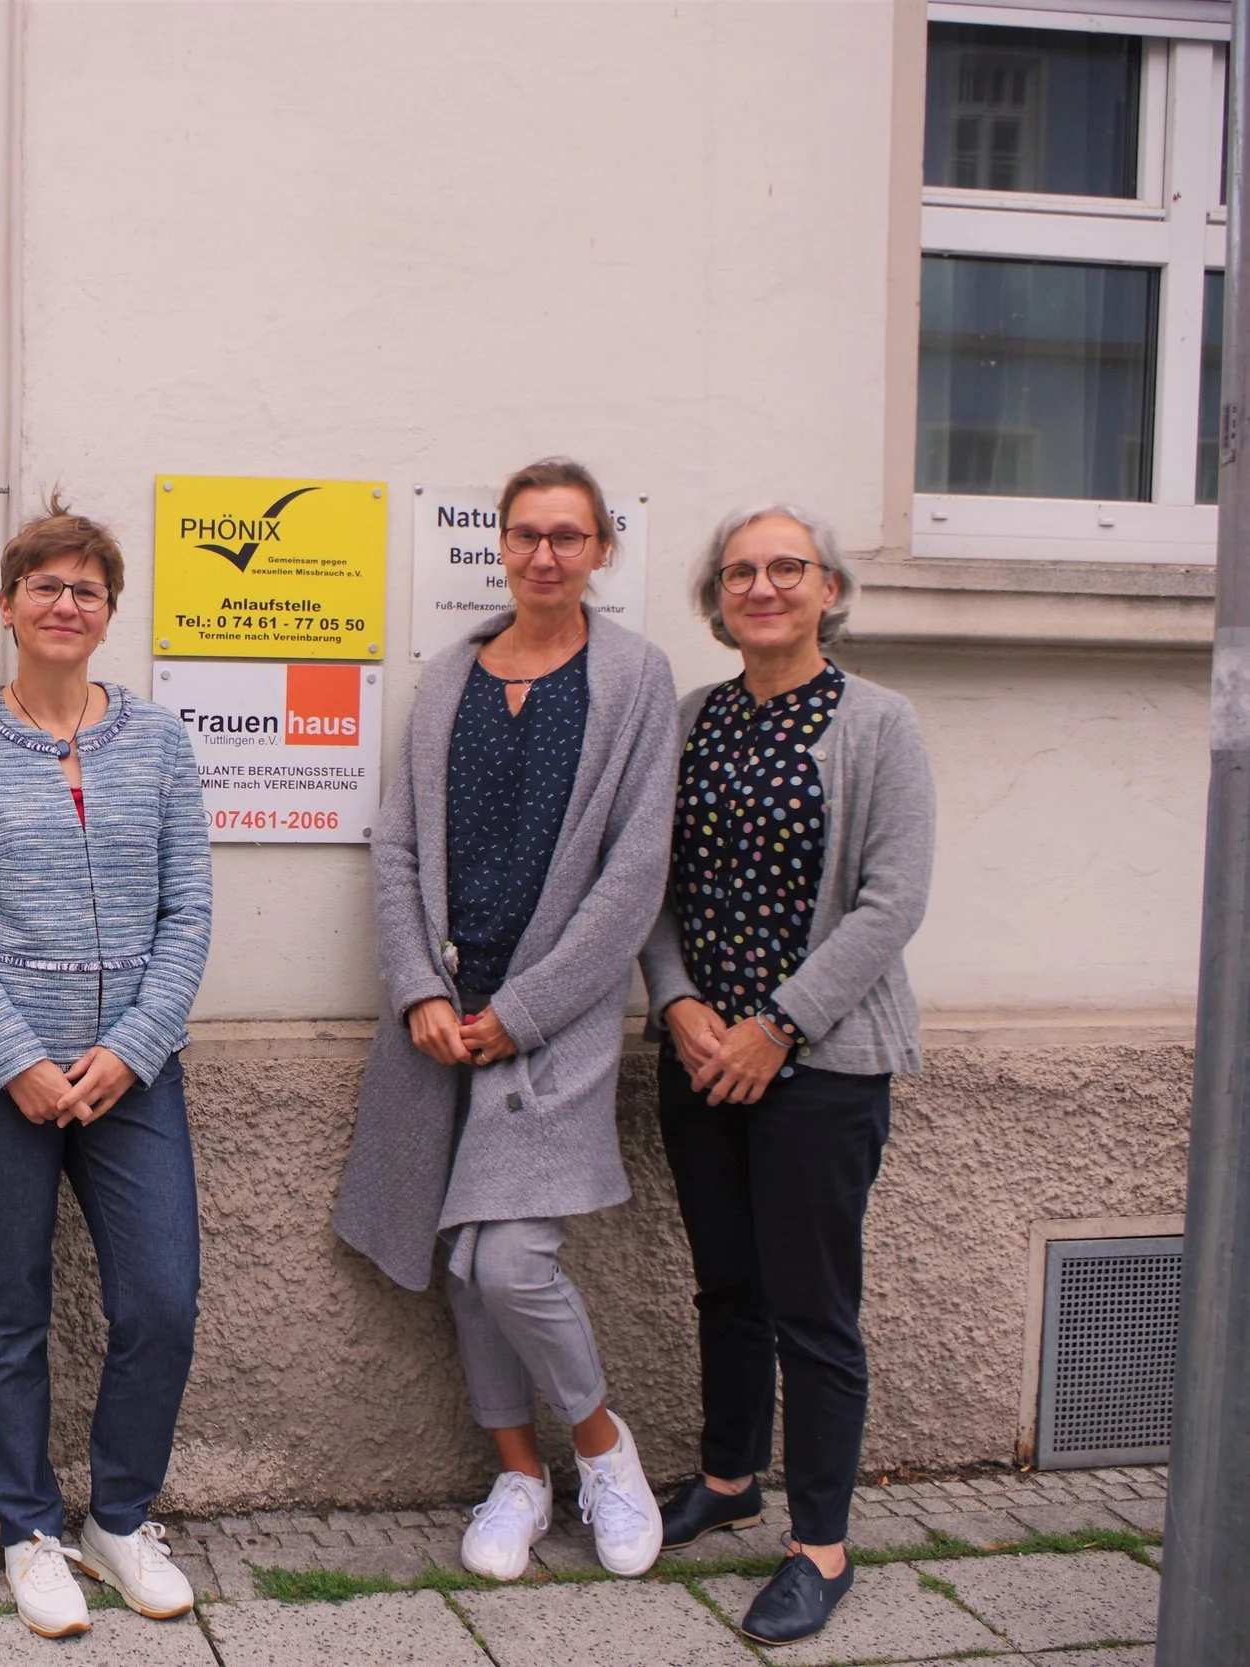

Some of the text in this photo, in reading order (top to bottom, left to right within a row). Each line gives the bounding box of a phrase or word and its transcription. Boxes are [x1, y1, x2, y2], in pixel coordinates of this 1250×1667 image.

[181, 514, 281, 541] PHÖNIX
[267, 556, 347, 567] Gemeinsam gegen
[251, 567, 362, 578] sexuellen Missbrauch e.V.
[220, 597, 322, 613] Anlaufstelle
[175, 614, 211, 628] Tel.:
[216, 615, 227, 628] 0
[232, 615, 253, 629] 74
[258, 616, 277, 629] 61
[294, 617, 315, 630] 77
[319, 618, 340, 631] 05
[345, 618, 365, 632] 50
[198, 631, 342, 645] Termine nach Vereinbarung
[180, 709, 356, 735] Frauen haus
[203, 734, 278, 747] Tuttlingen e.V.
[197, 766, 365, 778] ULANTE BERATUNGSSTELLE
[199, 778, 358, 791] MINE nach VEREINBARUNG
[215, 810, 339, 830] 07461-2066
